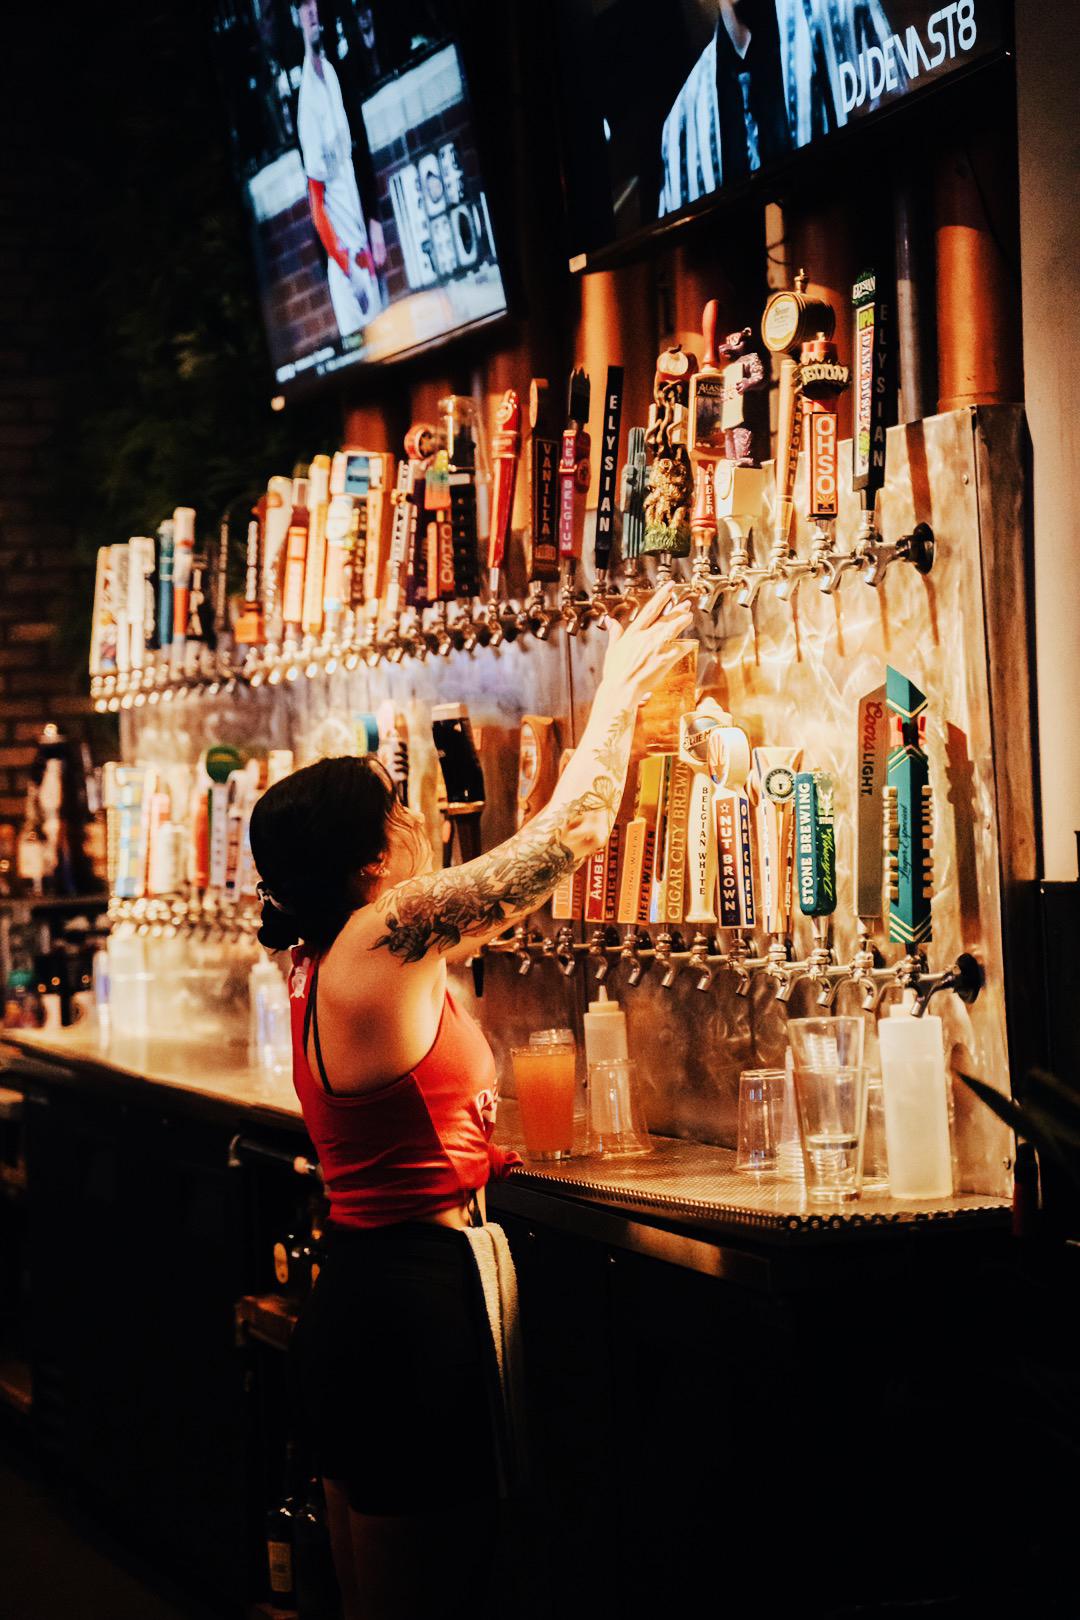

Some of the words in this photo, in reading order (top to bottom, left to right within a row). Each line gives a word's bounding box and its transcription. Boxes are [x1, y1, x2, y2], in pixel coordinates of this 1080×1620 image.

[873, 304, 888, 467] ELYSIAN
[564, 438, 575, 467] NEW
[600, 395, 618, 533] ELYSIAN
[816, 416, 835, 494] OHSO
[541, 443, 553, 535] VANILLA
[562, 480, 573, 551] BELGIUM
[672, 760, 688, 819] BREWIN
[861, 753, 875, 796] LIGHT
[670, 824, 685, 863] CITY
[700, 787, 708, 847] BELGIAN
[721, 815, 733, 849] NUT
[740, 804, 748, 844] OAK
[798, 783, 813, 854] BREWING
[638, 830, 656, 921] HEFEWEIZEN
[667, 868, 682, 919] CIGAR
[698, 852, 707, 895] WHITE
[723, 854, 736, 910] BROWN
[743, 851, 753, 919] CREEK
[801, 857, 814, 905] STONE
